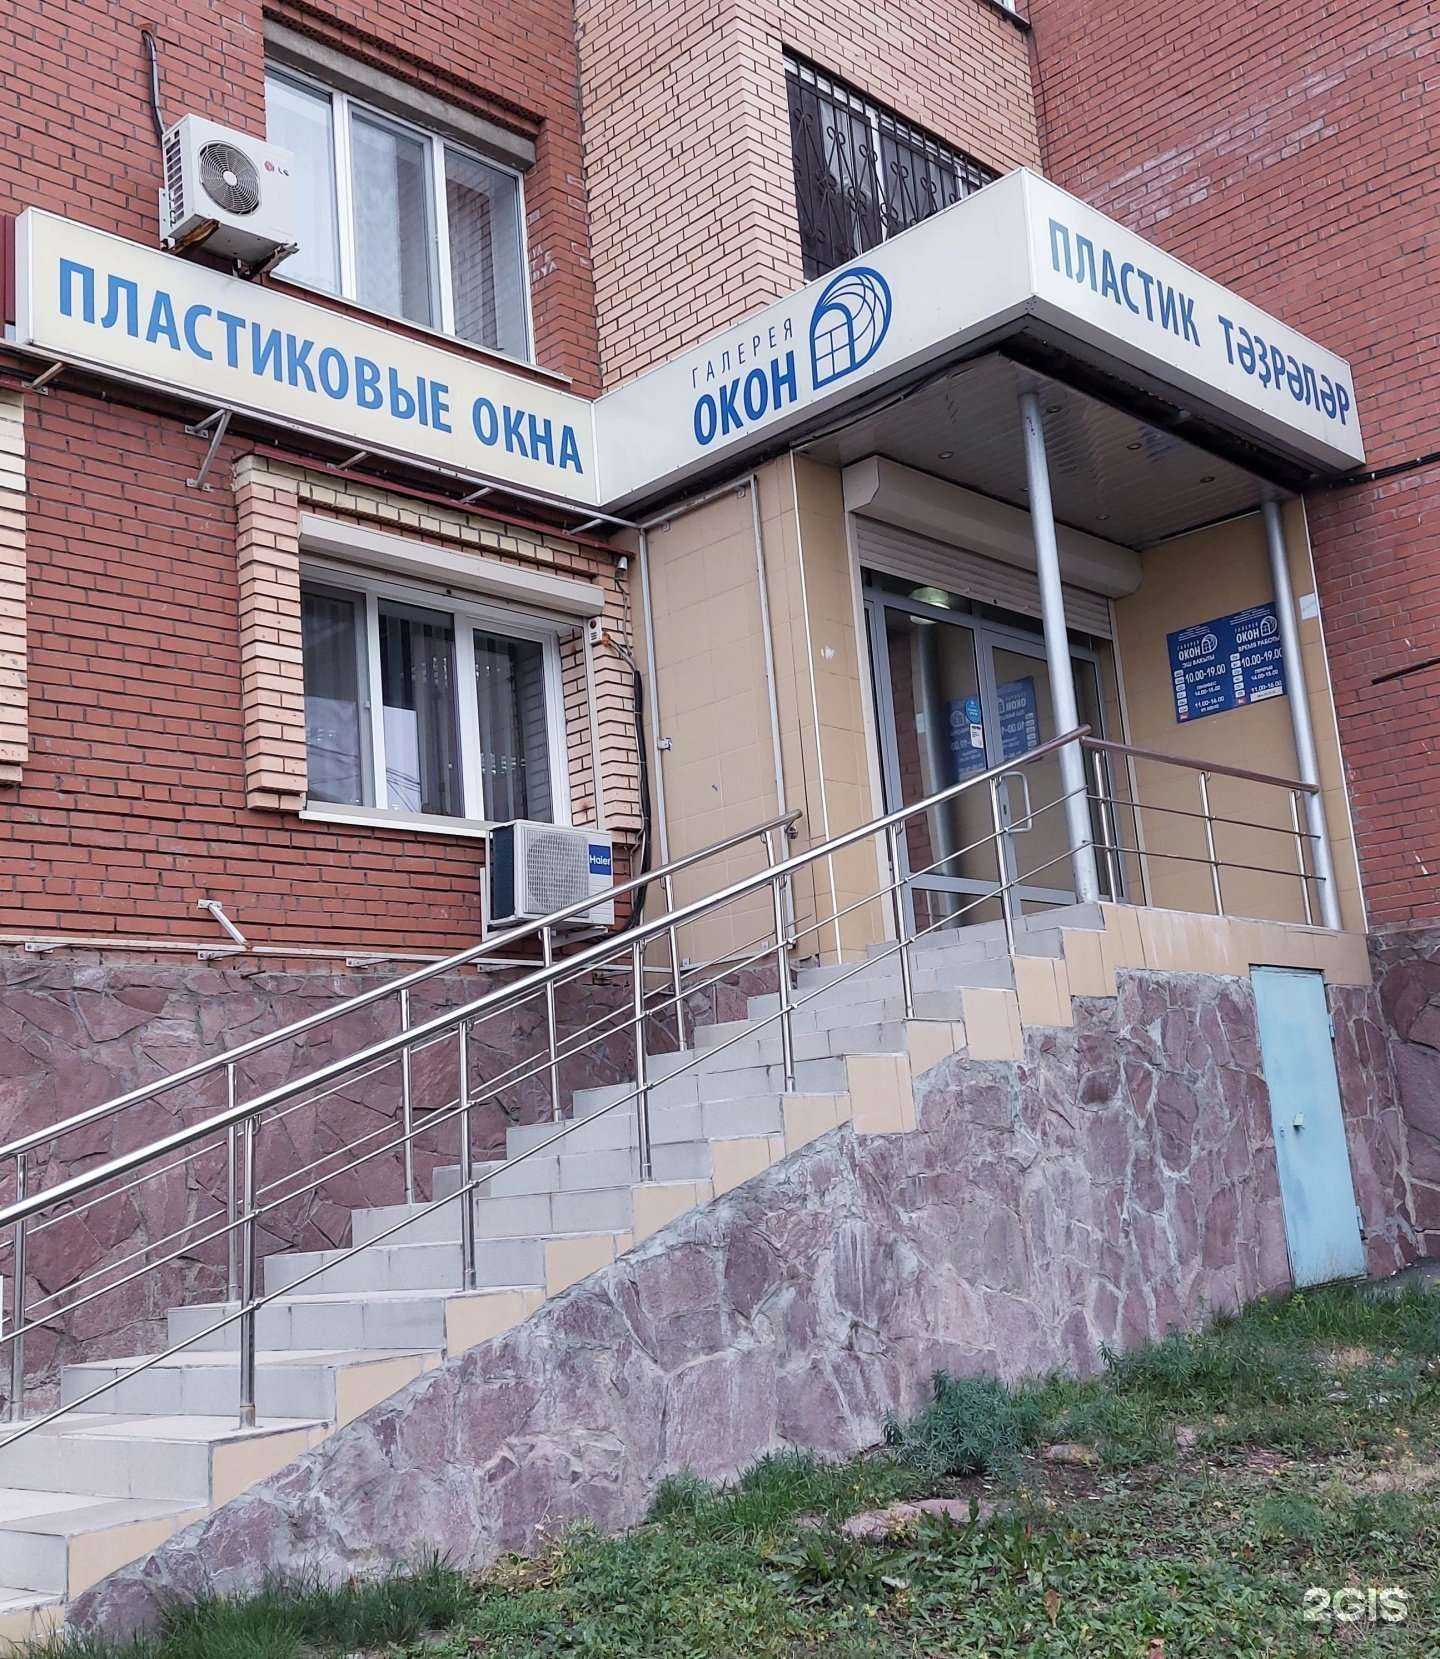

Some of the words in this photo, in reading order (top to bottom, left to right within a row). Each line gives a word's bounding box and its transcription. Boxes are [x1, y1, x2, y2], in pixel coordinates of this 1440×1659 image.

[1048, 217, 1201, 347] ПЛАСТИК
[1217, 314, 1351, 425] ТӘҘРӘЛӘР
[57, 258, 453, 433] ПЛАСТИКОВЫЕ
[470, 396, 583, 475] ОКНА
[691, 317, 794, 389] ГАЛЕРЕЯ
[693, 350, 799, 446] ОКОН
[1178, 645, 1201, 661] ОКОН
[1236, 628, 1260, 644] ОКОН
[1185, 663, 1226, 684] 10.00-19.00
[589, 854, 611, 867] Haier
